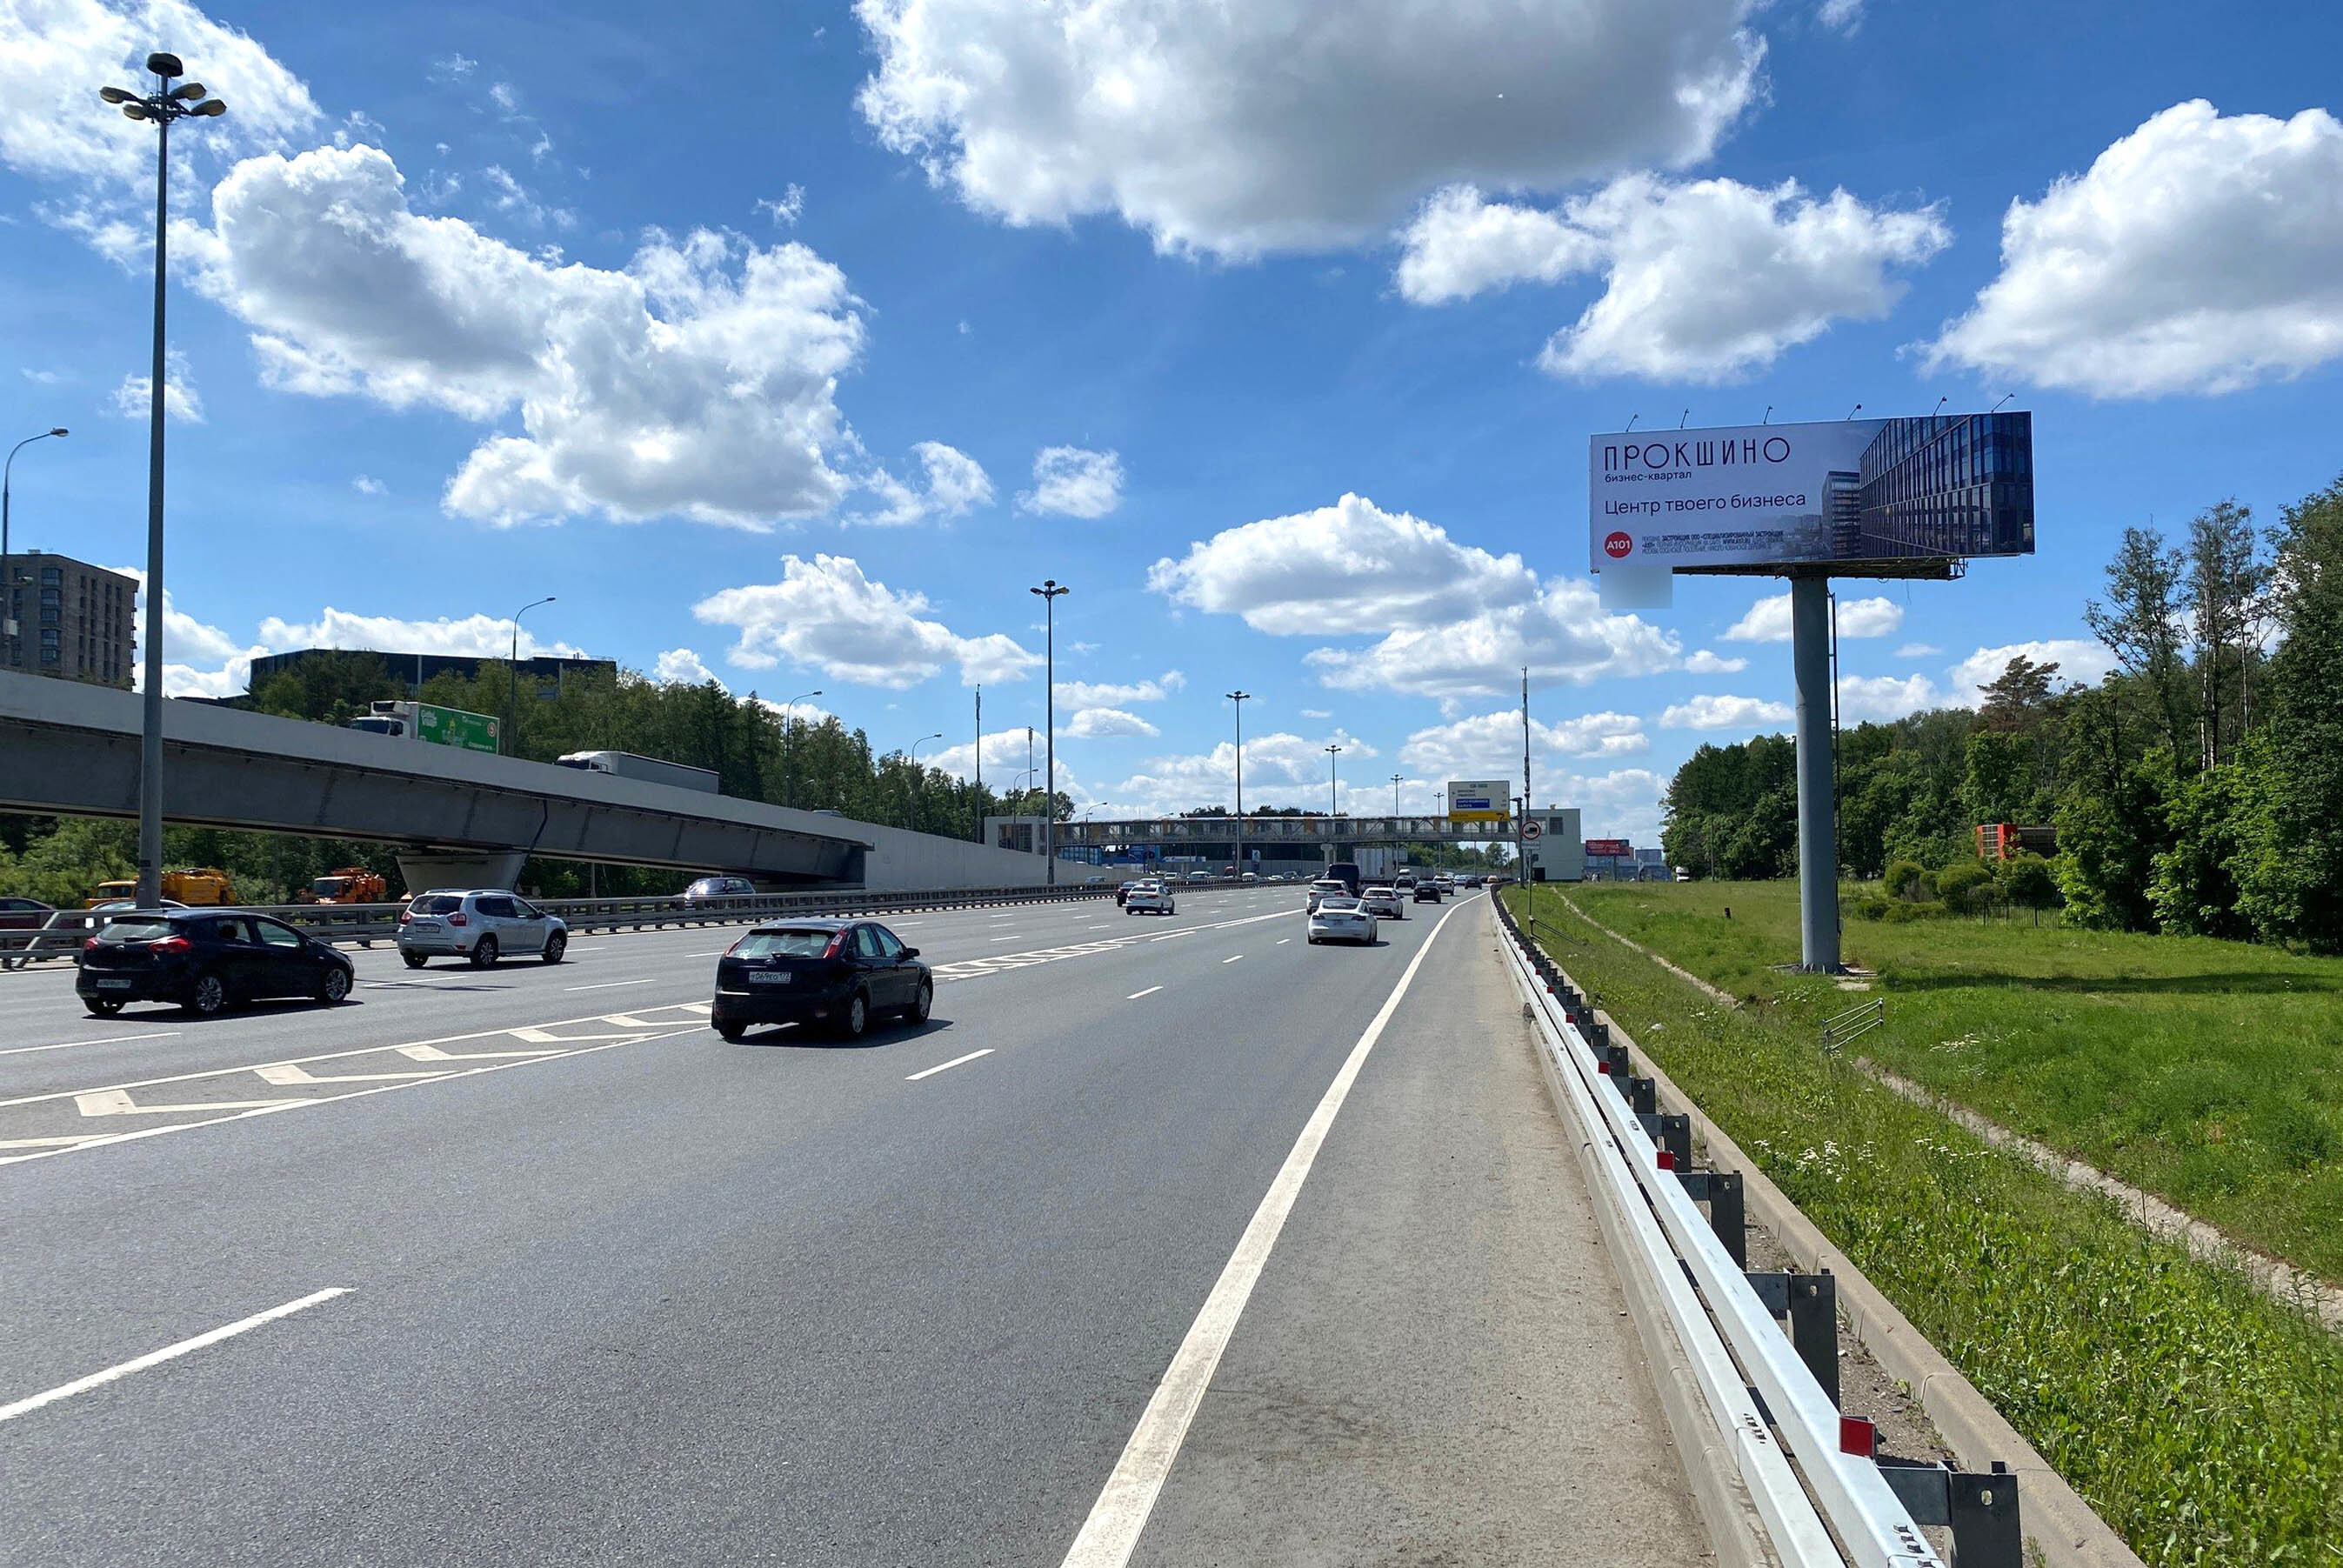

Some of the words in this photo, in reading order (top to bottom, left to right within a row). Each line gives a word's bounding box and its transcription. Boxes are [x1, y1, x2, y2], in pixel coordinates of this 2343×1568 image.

[1605, 437, 1790, 470] ПРОКШИНО
[1605, 470, 1692, 483] бизнес-квартал
[1605, 500, 1660, 516] Центр
[1665, 497, 1726, 511] твоего
[1731, 493, 1806, 508] бизнеса
[1606, 540, 1631, 550] А101
